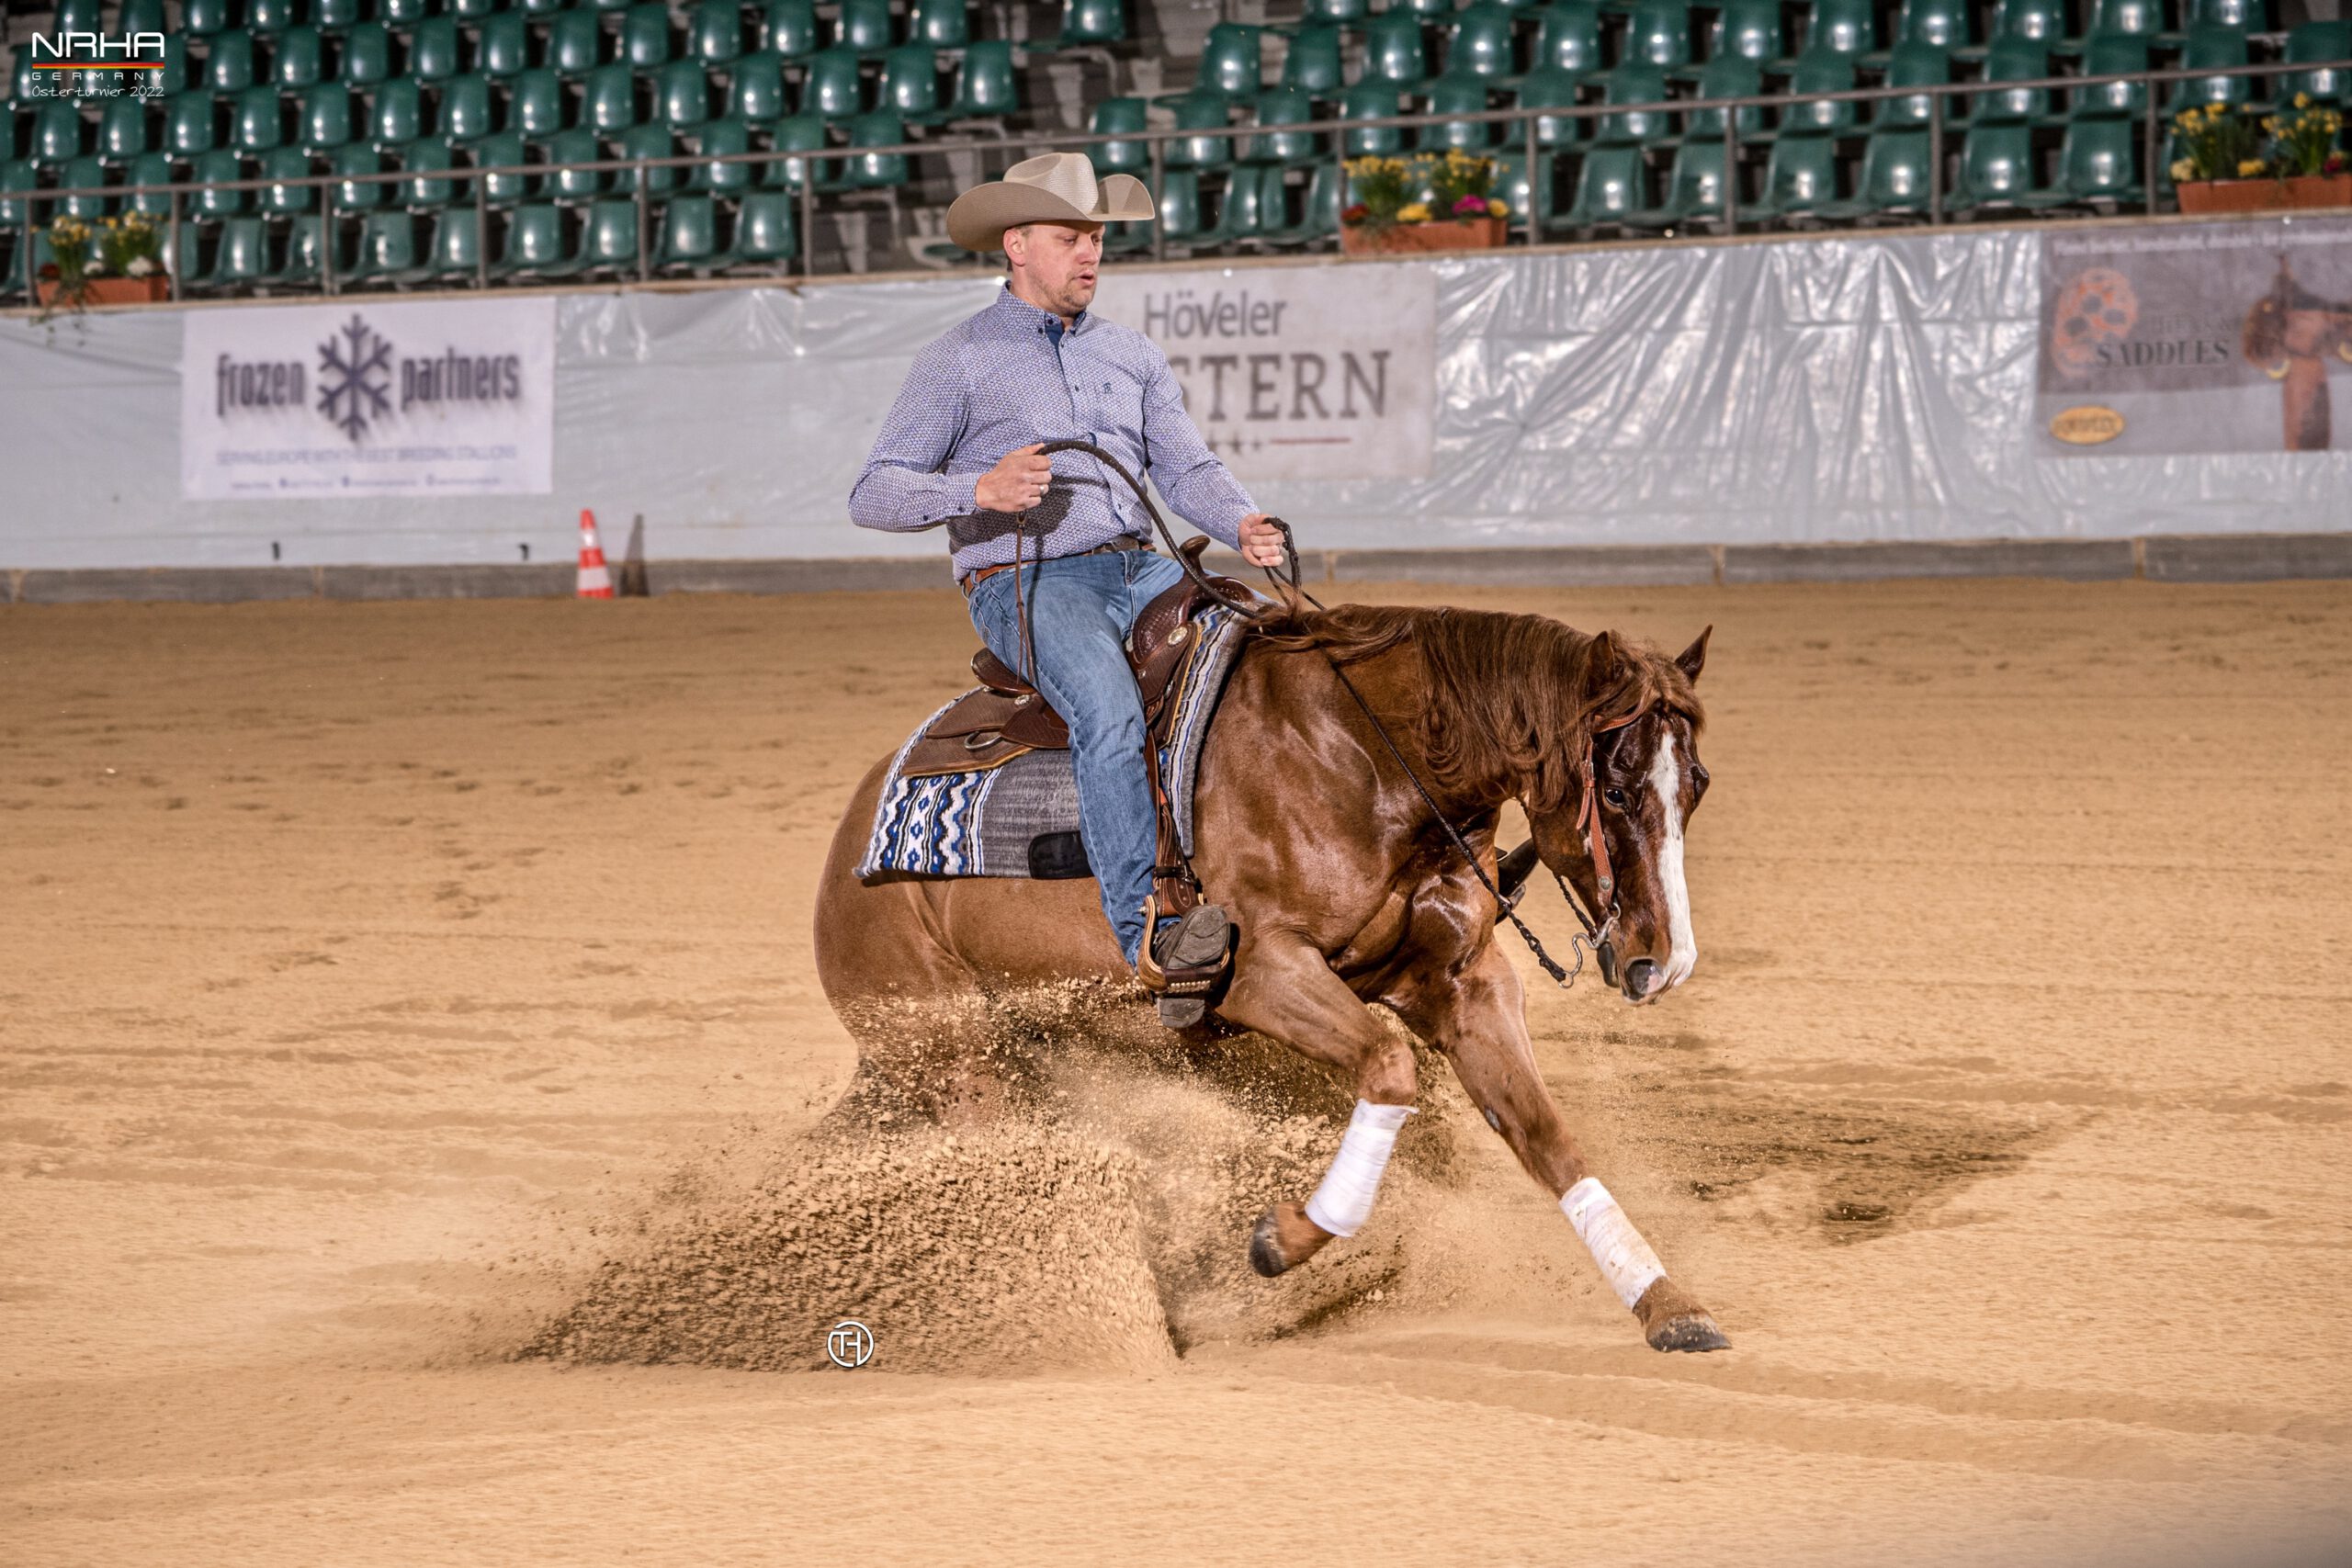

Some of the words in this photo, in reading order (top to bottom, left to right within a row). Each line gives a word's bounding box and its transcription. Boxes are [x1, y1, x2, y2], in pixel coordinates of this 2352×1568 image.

[2096, 339, 2230, 367] SADDLES
[216, 352, 306, 417] frozen
[401, 346, 521, 412] partners
